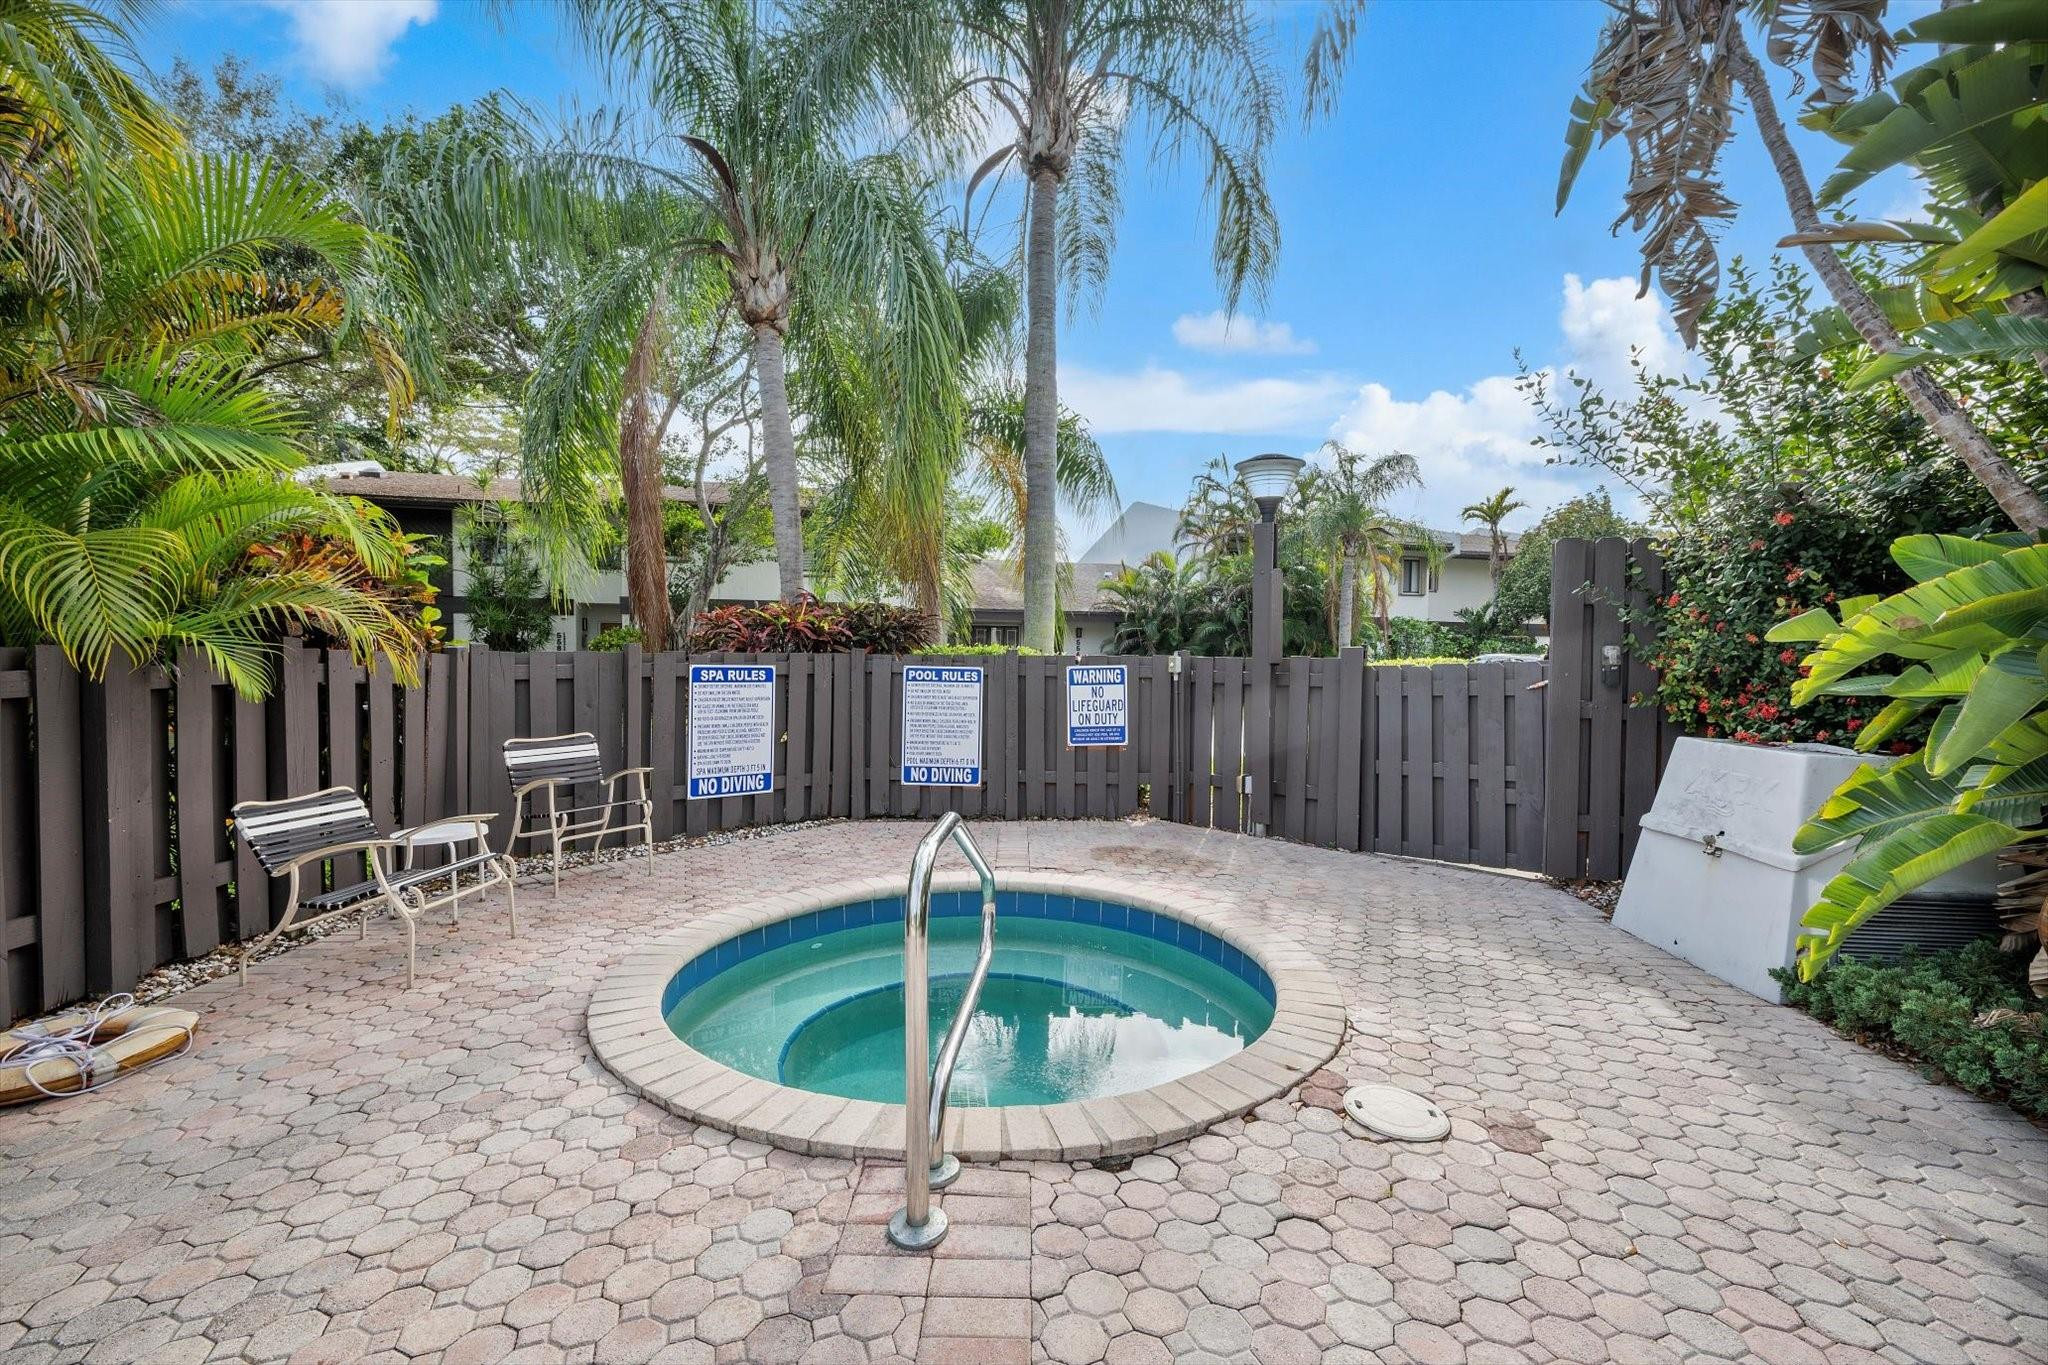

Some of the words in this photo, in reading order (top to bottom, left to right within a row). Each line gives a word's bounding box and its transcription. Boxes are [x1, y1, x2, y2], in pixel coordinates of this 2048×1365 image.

[700, 670, 724, 681] SPA
[728, 670, 766, 681] RULES
[908, 670, 939, 681] POOL
[942, 671, 978, 681] RULES
[1073, 670, 1121, 684] WARNING
[1091, 686, 1104, 698] NO
[1072, 699, 1124, 712] LIFEGUARD
[1078, 713, 1091, 725] ON
[1094, 713, 1118, 725] DUTY
[696, 768, 706, 776] SPA
[730, 765, 745, 773] DEPTH
[910, 767, 928, 782] NO
[931, 768, 972, 783] DIVING
[698, 778, 717, 795] NO
[721, 775, 765, 793] DIVING
